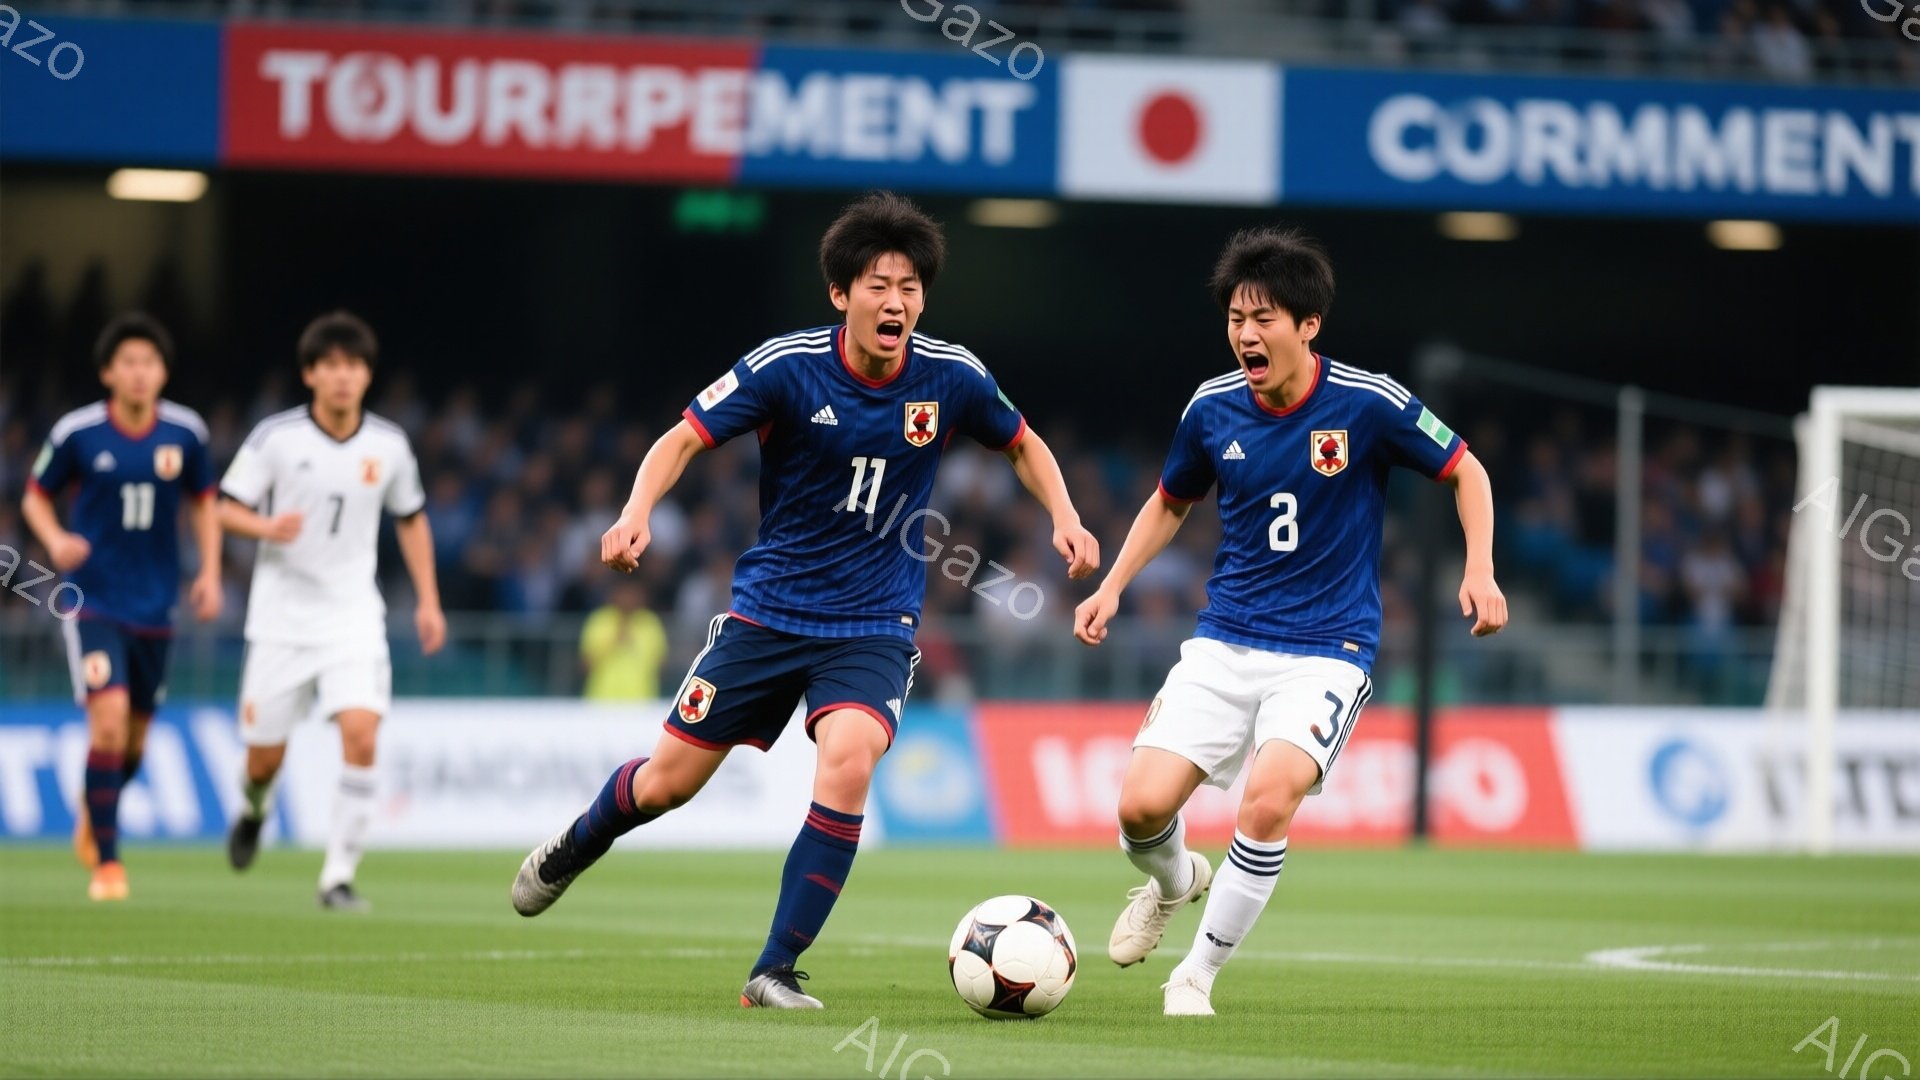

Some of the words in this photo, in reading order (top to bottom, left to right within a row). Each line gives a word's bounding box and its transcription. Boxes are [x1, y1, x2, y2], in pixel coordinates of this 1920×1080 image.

[119, 482, 156, 531] 11
[847, 456, 887, 514] 11
[327, 494, 345, 535] 7
[1310, 690, 1344, 748] 3
